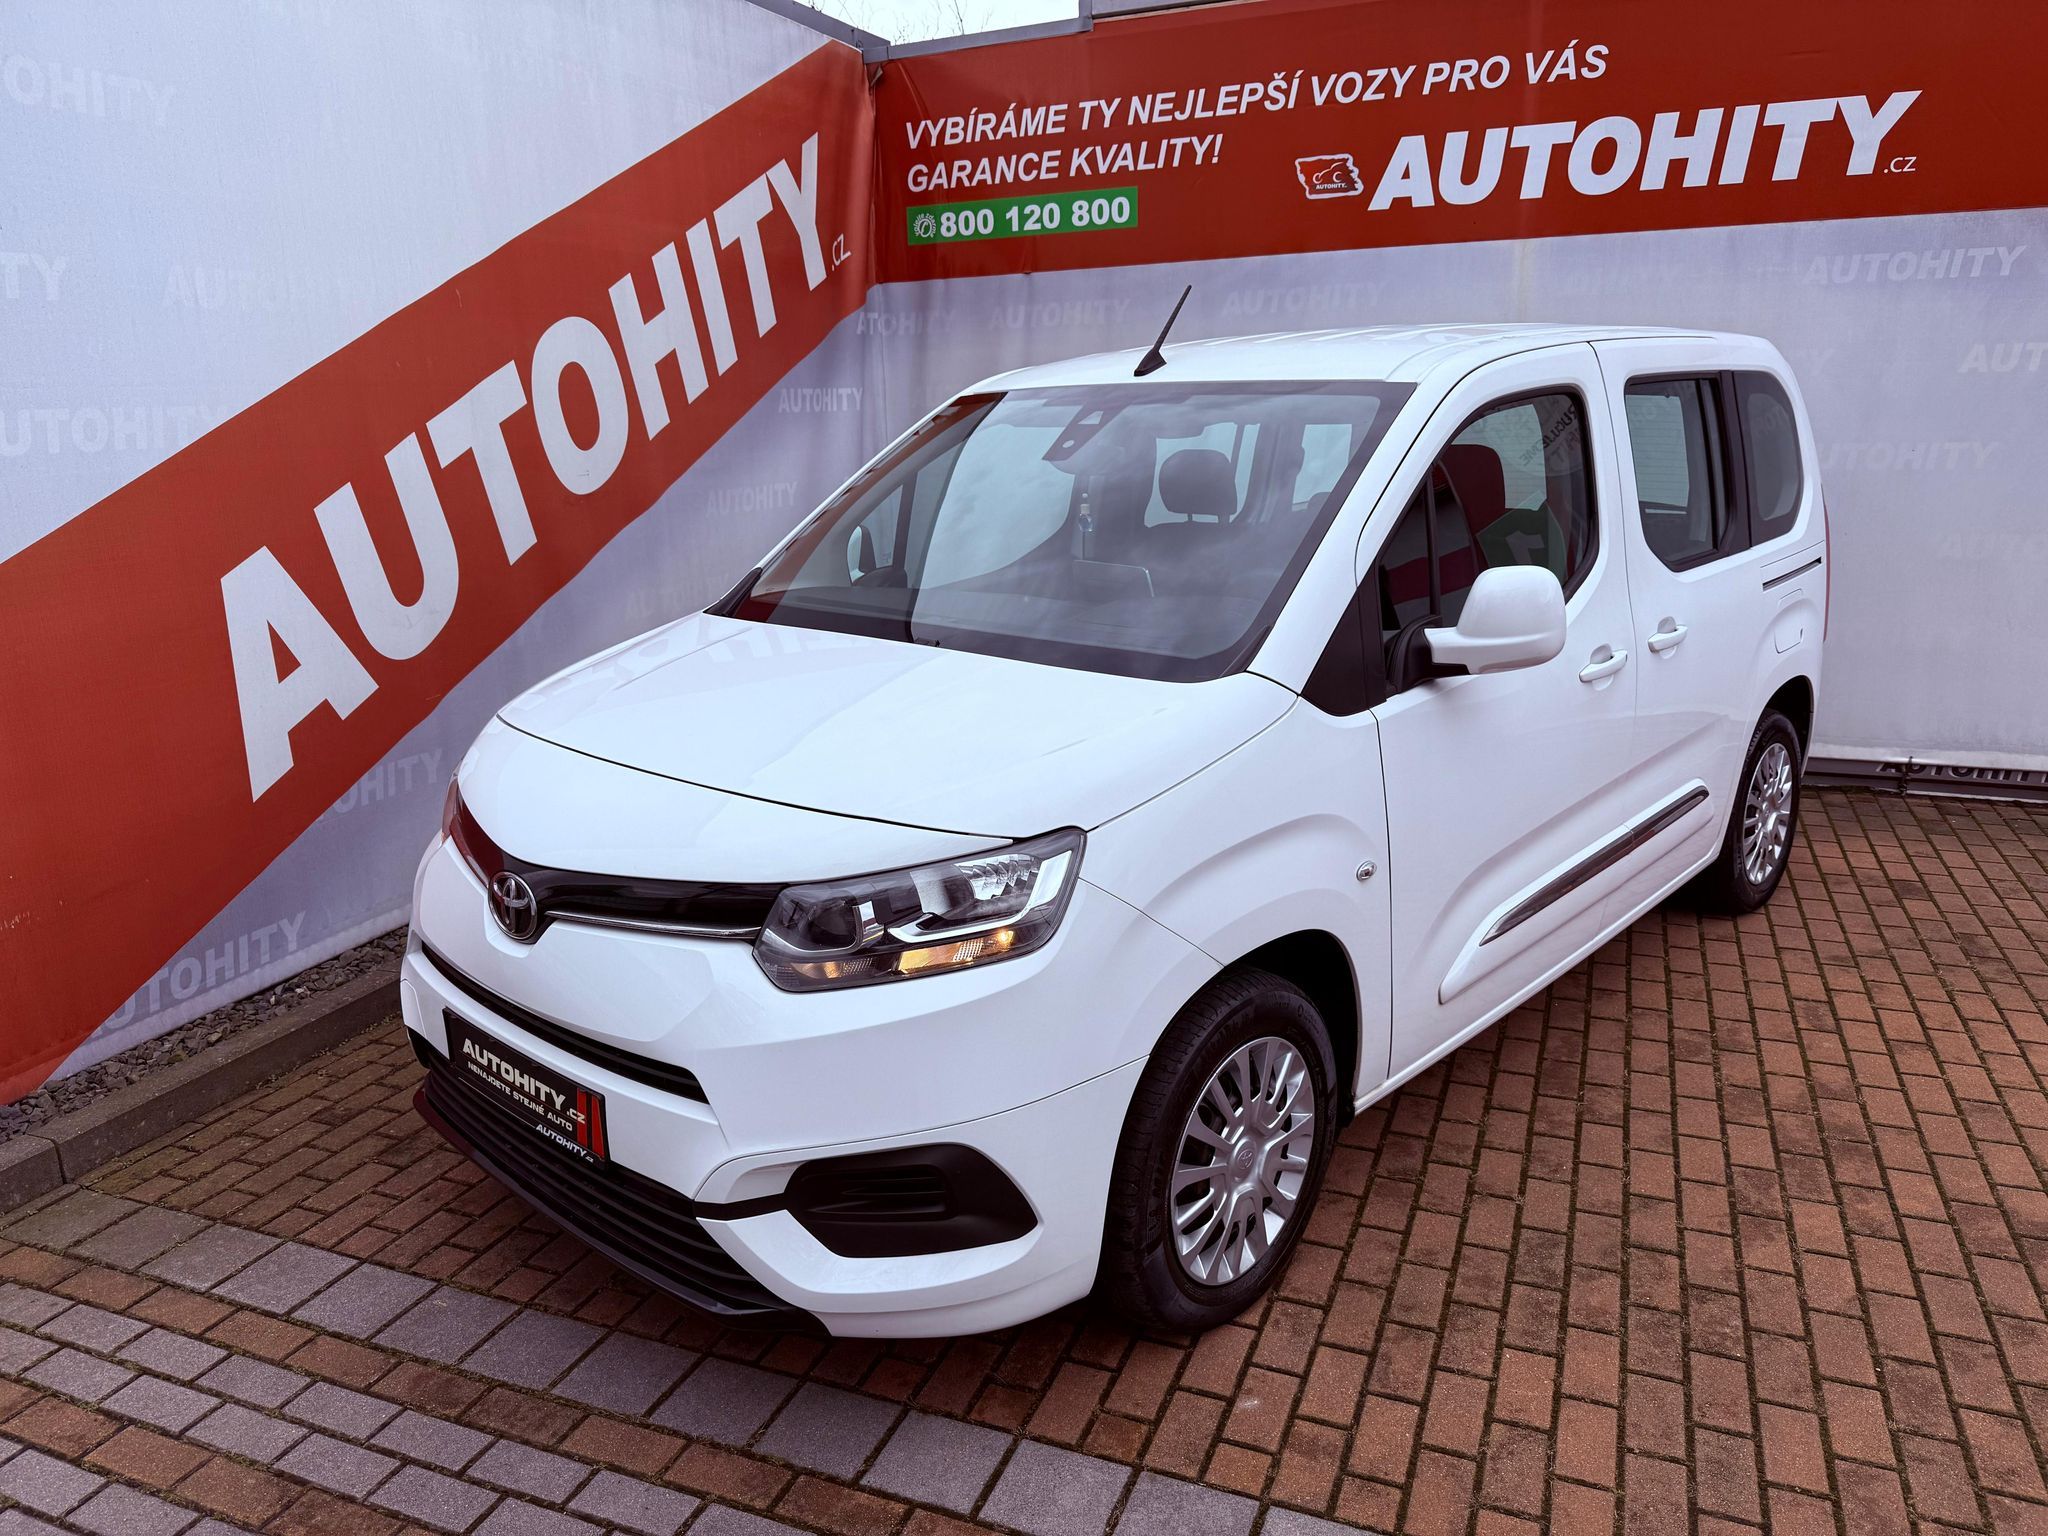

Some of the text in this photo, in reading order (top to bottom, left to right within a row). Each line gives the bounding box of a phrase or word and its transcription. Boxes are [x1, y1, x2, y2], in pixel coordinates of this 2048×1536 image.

[905, 38, 1611, 149] VYBÍRÁME TY NEJLEPŠÍ VOZY PRO VÁS
[906, 133, 1225, 193] GARANCE KVALITY!
[939, 196, 1131, 238] 800 120 800
[1801, 246, 2027, 285] AUTOHITY
[777, 386, 864, 414] AUTOHITY
[547, 1111, 573, 1131] AUTO
